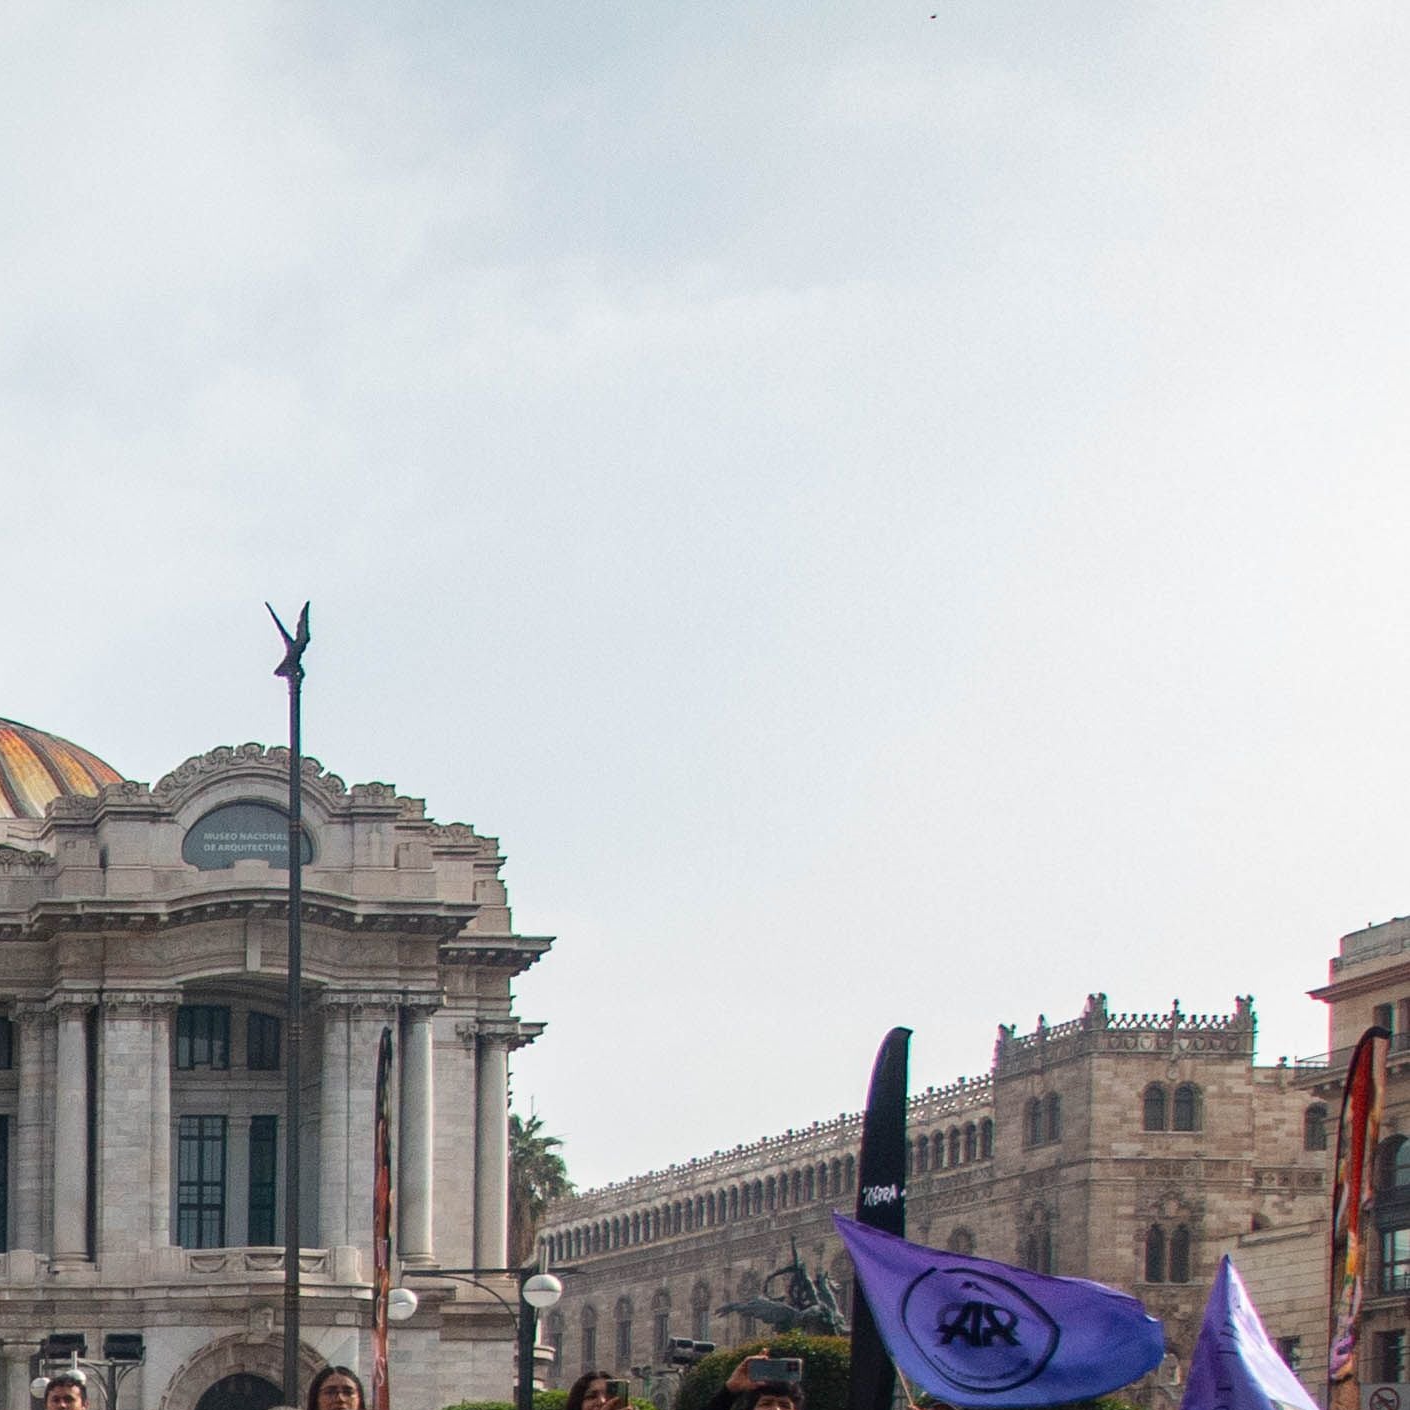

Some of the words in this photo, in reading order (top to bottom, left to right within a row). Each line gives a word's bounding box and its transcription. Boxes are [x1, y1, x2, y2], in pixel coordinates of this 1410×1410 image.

[203, 832, 238, 841] MUSEO
[240, 832, 289, 841] NACIONAL
[203, 843, 216, 852] DE
[217, 843, 290, 852] ARQUITECTURA
